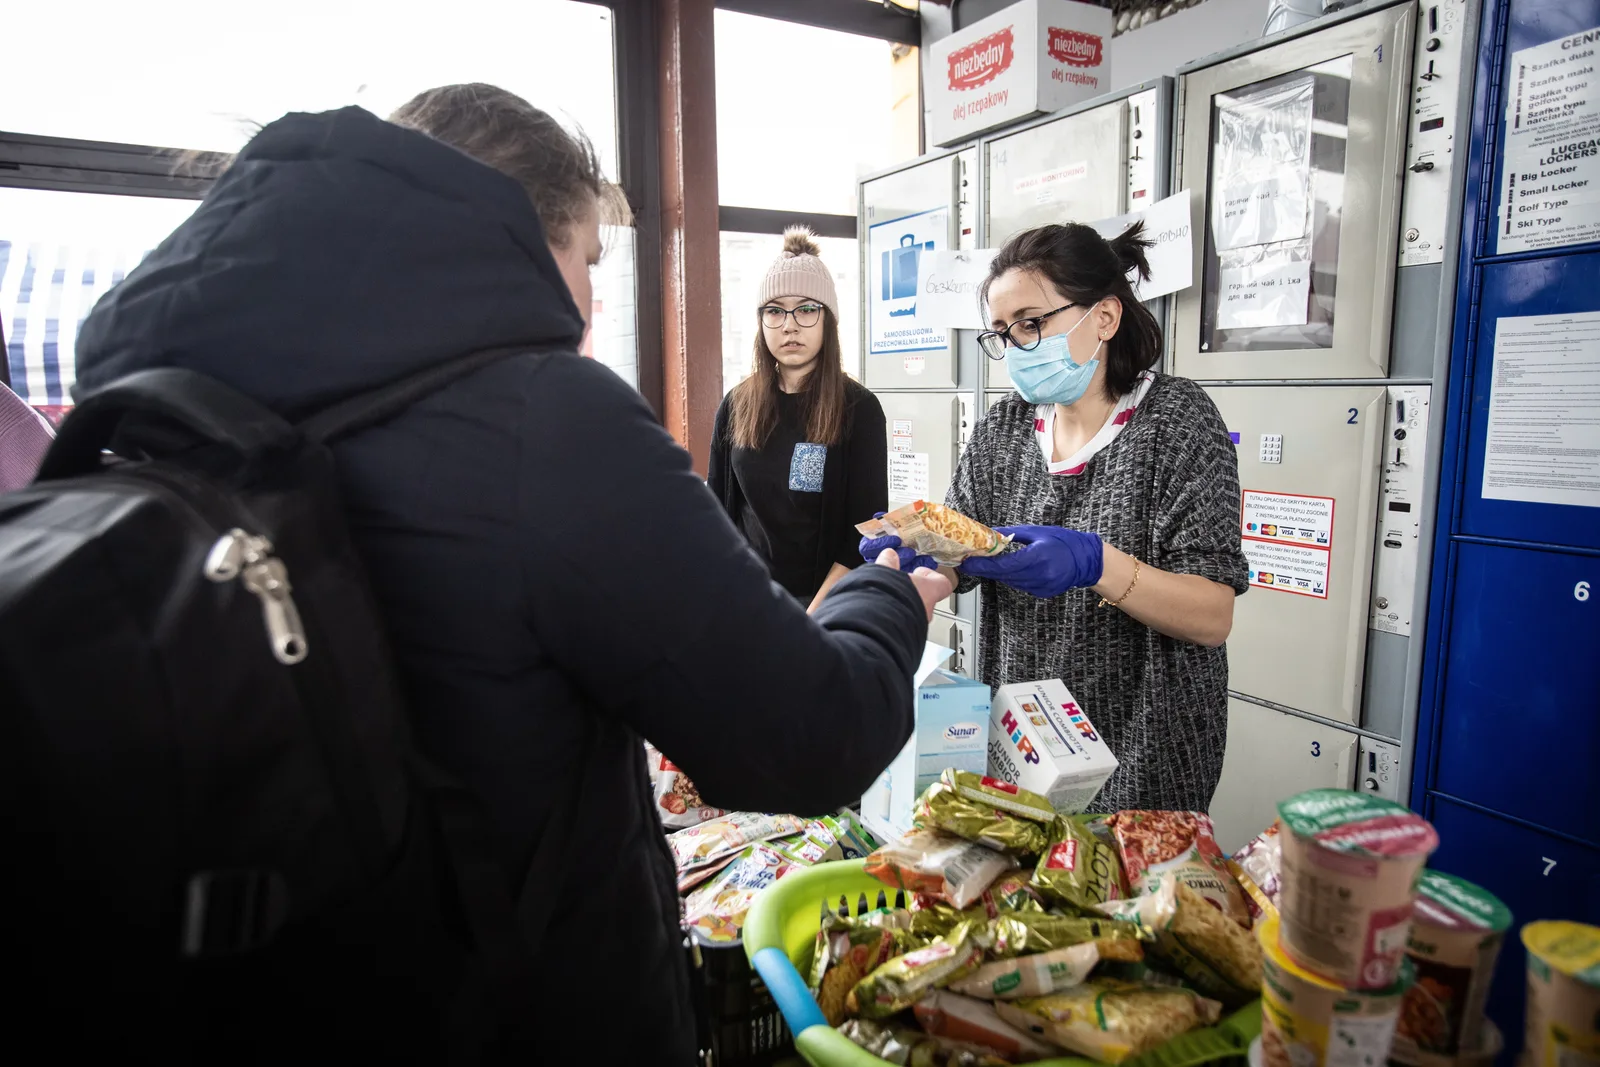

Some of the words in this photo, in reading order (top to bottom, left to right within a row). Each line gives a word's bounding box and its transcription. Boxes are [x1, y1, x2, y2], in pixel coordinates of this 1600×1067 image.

[1054, 35, 1097, 60] niezbędny
[954, 42, 1005, 80] niezbędny
[1531, 58, 1566, 72] Szafka
[1568, 49, 1594, 61] duża
[1051, 67, 1064, 83] olej
[1065, 72, 1099, 89] rzepakowy
[1530, 75, 1564, 88] Szafka
[1567, 66, 1593, 78] mała
[1529, 88, 1562, 102] Szafka
[1565, 82, 1588, 93] typu
[953, 102, 966, 121] olej
[967, 89, 1009, 115] rzepakowy
[1527, 105, 1560, 119] Szafka
[1563, 100, 1586, 111] typu
[1528, 95, 1567, 109] golfowa
[1526, 110, 1574, 125] narciarka
[1540, 147, 1598, 166] LOCKERS
[1041, 166, 1085, 183] MONITORING
[1521, 173, 1538, 181] Big
[1540, 165, 1578, 177] Locker
[1520, 185, 1549, 197] Small
[1551, 179, 1589, 191] Locker
[1225, 196, 1251, 207] гарячи
[1518, 203, 1540, 213] Golf
[1542, 199, 1568, 209] Type
[1517, 220, 1533, 229] Ski
[1535, 216, 1562, 226] Type
[1533, 236, 1552, 244] locking
[883, 327, 933, 339] SAMOOBSŁUGOWA
[874, 338, 919, 348] PRZECHOWALNIA
[1347, 407, 1359, 425] 2
[1259, 513, 1289, 521] INSTRUKCJĄ
[1279, 506, 1306, 514] POSTĘPUJ
[1272, 554, 1300, 563] CONTACTLESS
[1274, 563, 1293, 571] PAYMENT
[1573, 581, 1591, 602] 6
[1034, 685, 1057, 712] JUNIOR
[1061, 702, 1098, 742] HiPP
[947, 726, 978, 737] Sunar
[1000, 709, 1040, 765] HiPP
[1310, 741, 1321, 757] 3
[988, 742, 1018, 786] OMBIOT
[994, 739, 1021, 781] JUNIOR
[1541, 856, 1557, 877] 7
